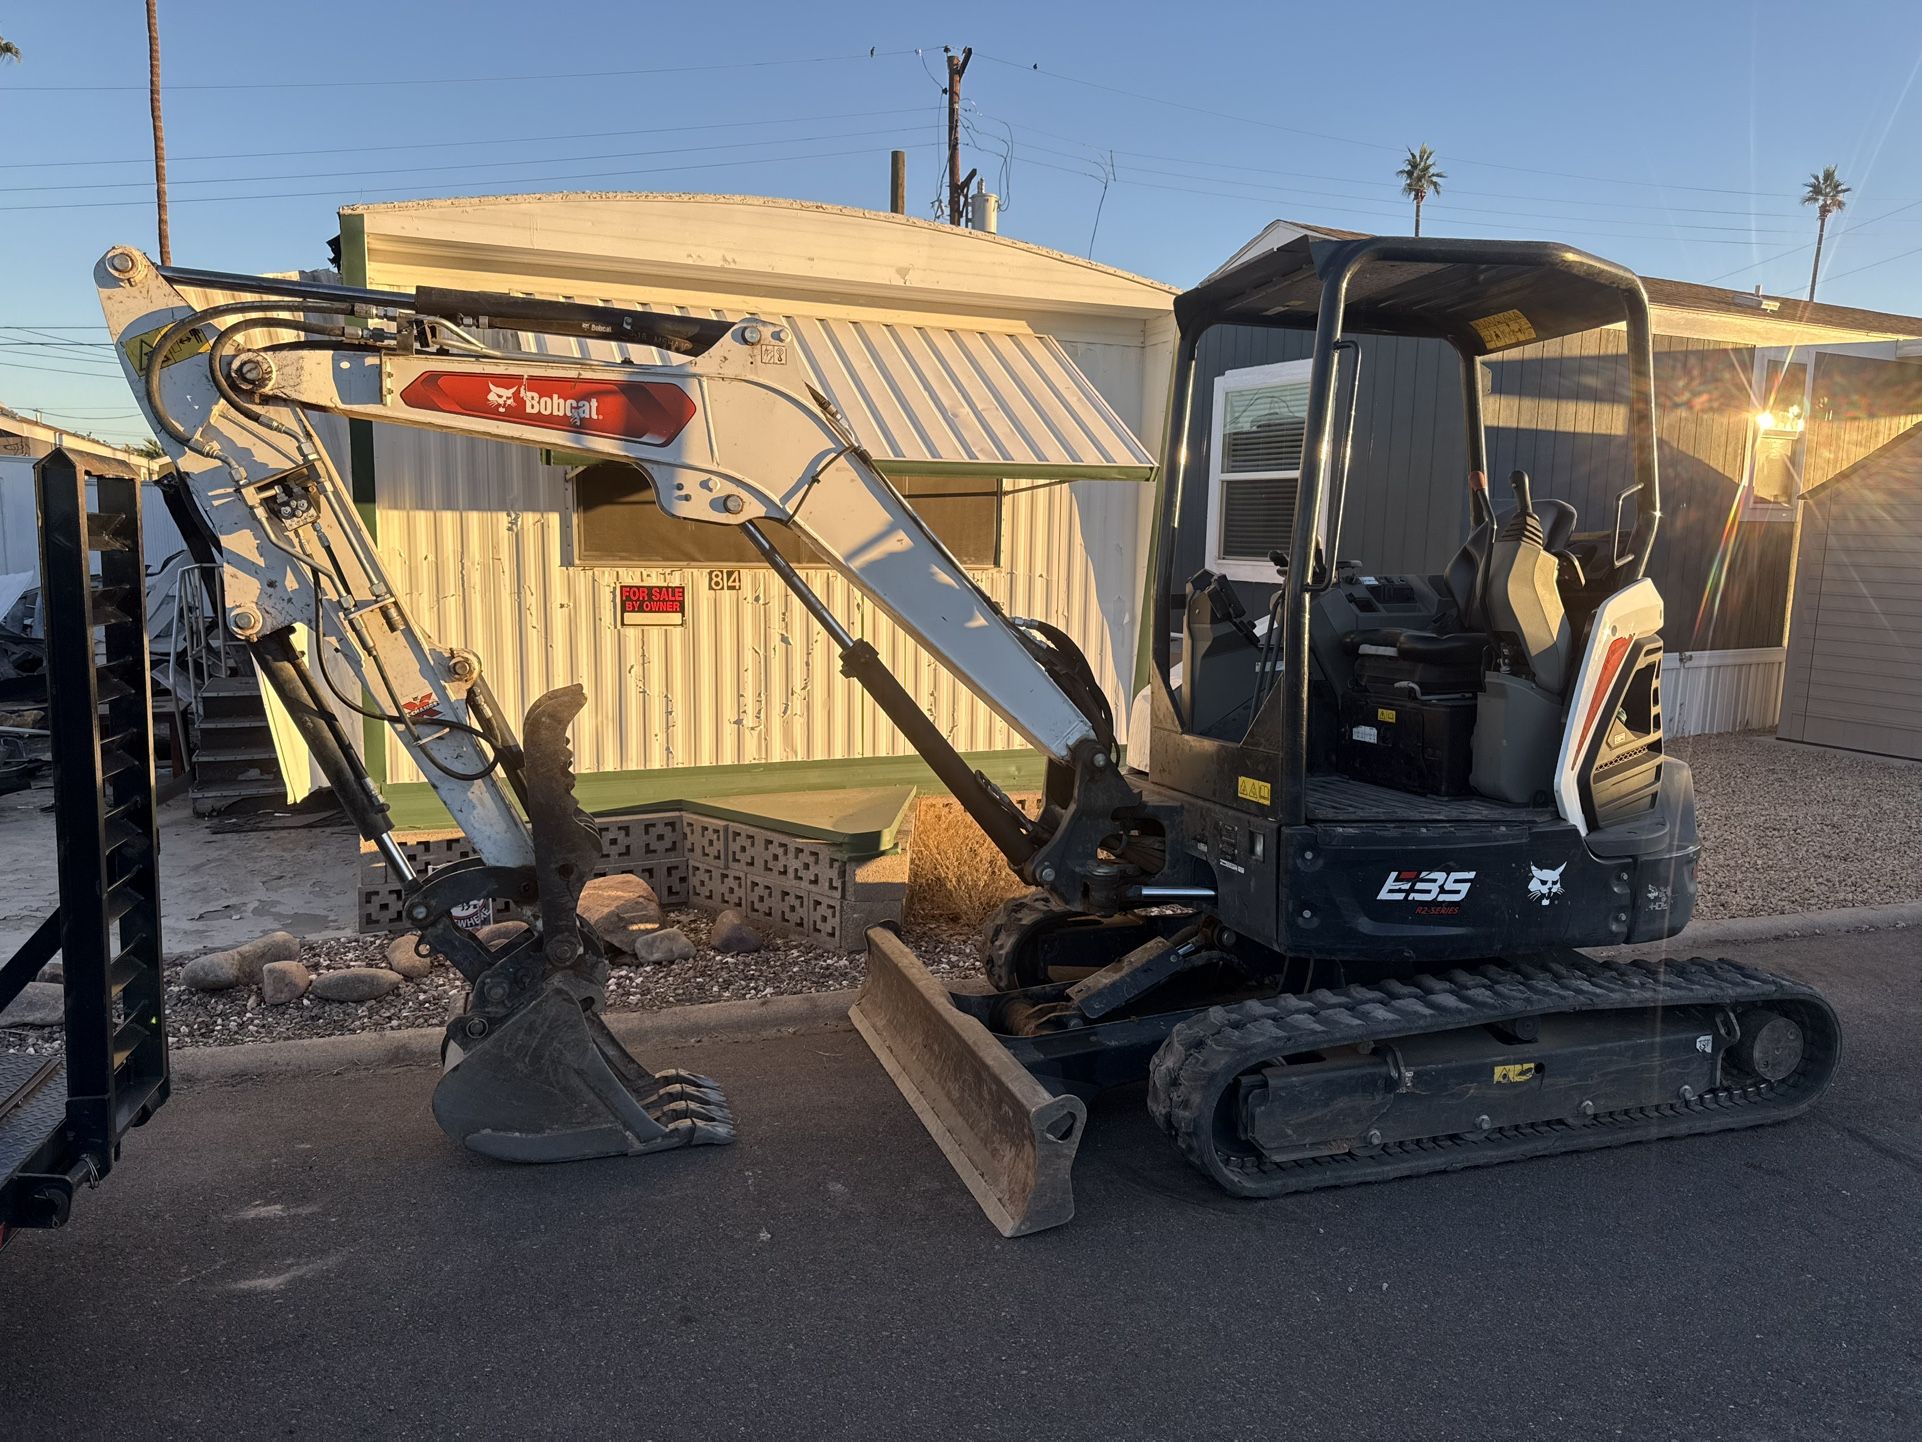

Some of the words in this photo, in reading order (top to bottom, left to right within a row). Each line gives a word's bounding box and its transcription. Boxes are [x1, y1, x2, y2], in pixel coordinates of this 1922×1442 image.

[525, 391, 600, 421] Bobcat
[710, 570, 741, 590] 84
[622, 587, 648, 600] FOR
[652, 587, 683, 601] SALE
[626, 602, 641, 612] BY
[644, 602, 680, 611] OWNER
[1376, 871, 1476, 901] E35
[1415, 906, 1459, 915] R2-SERIES
